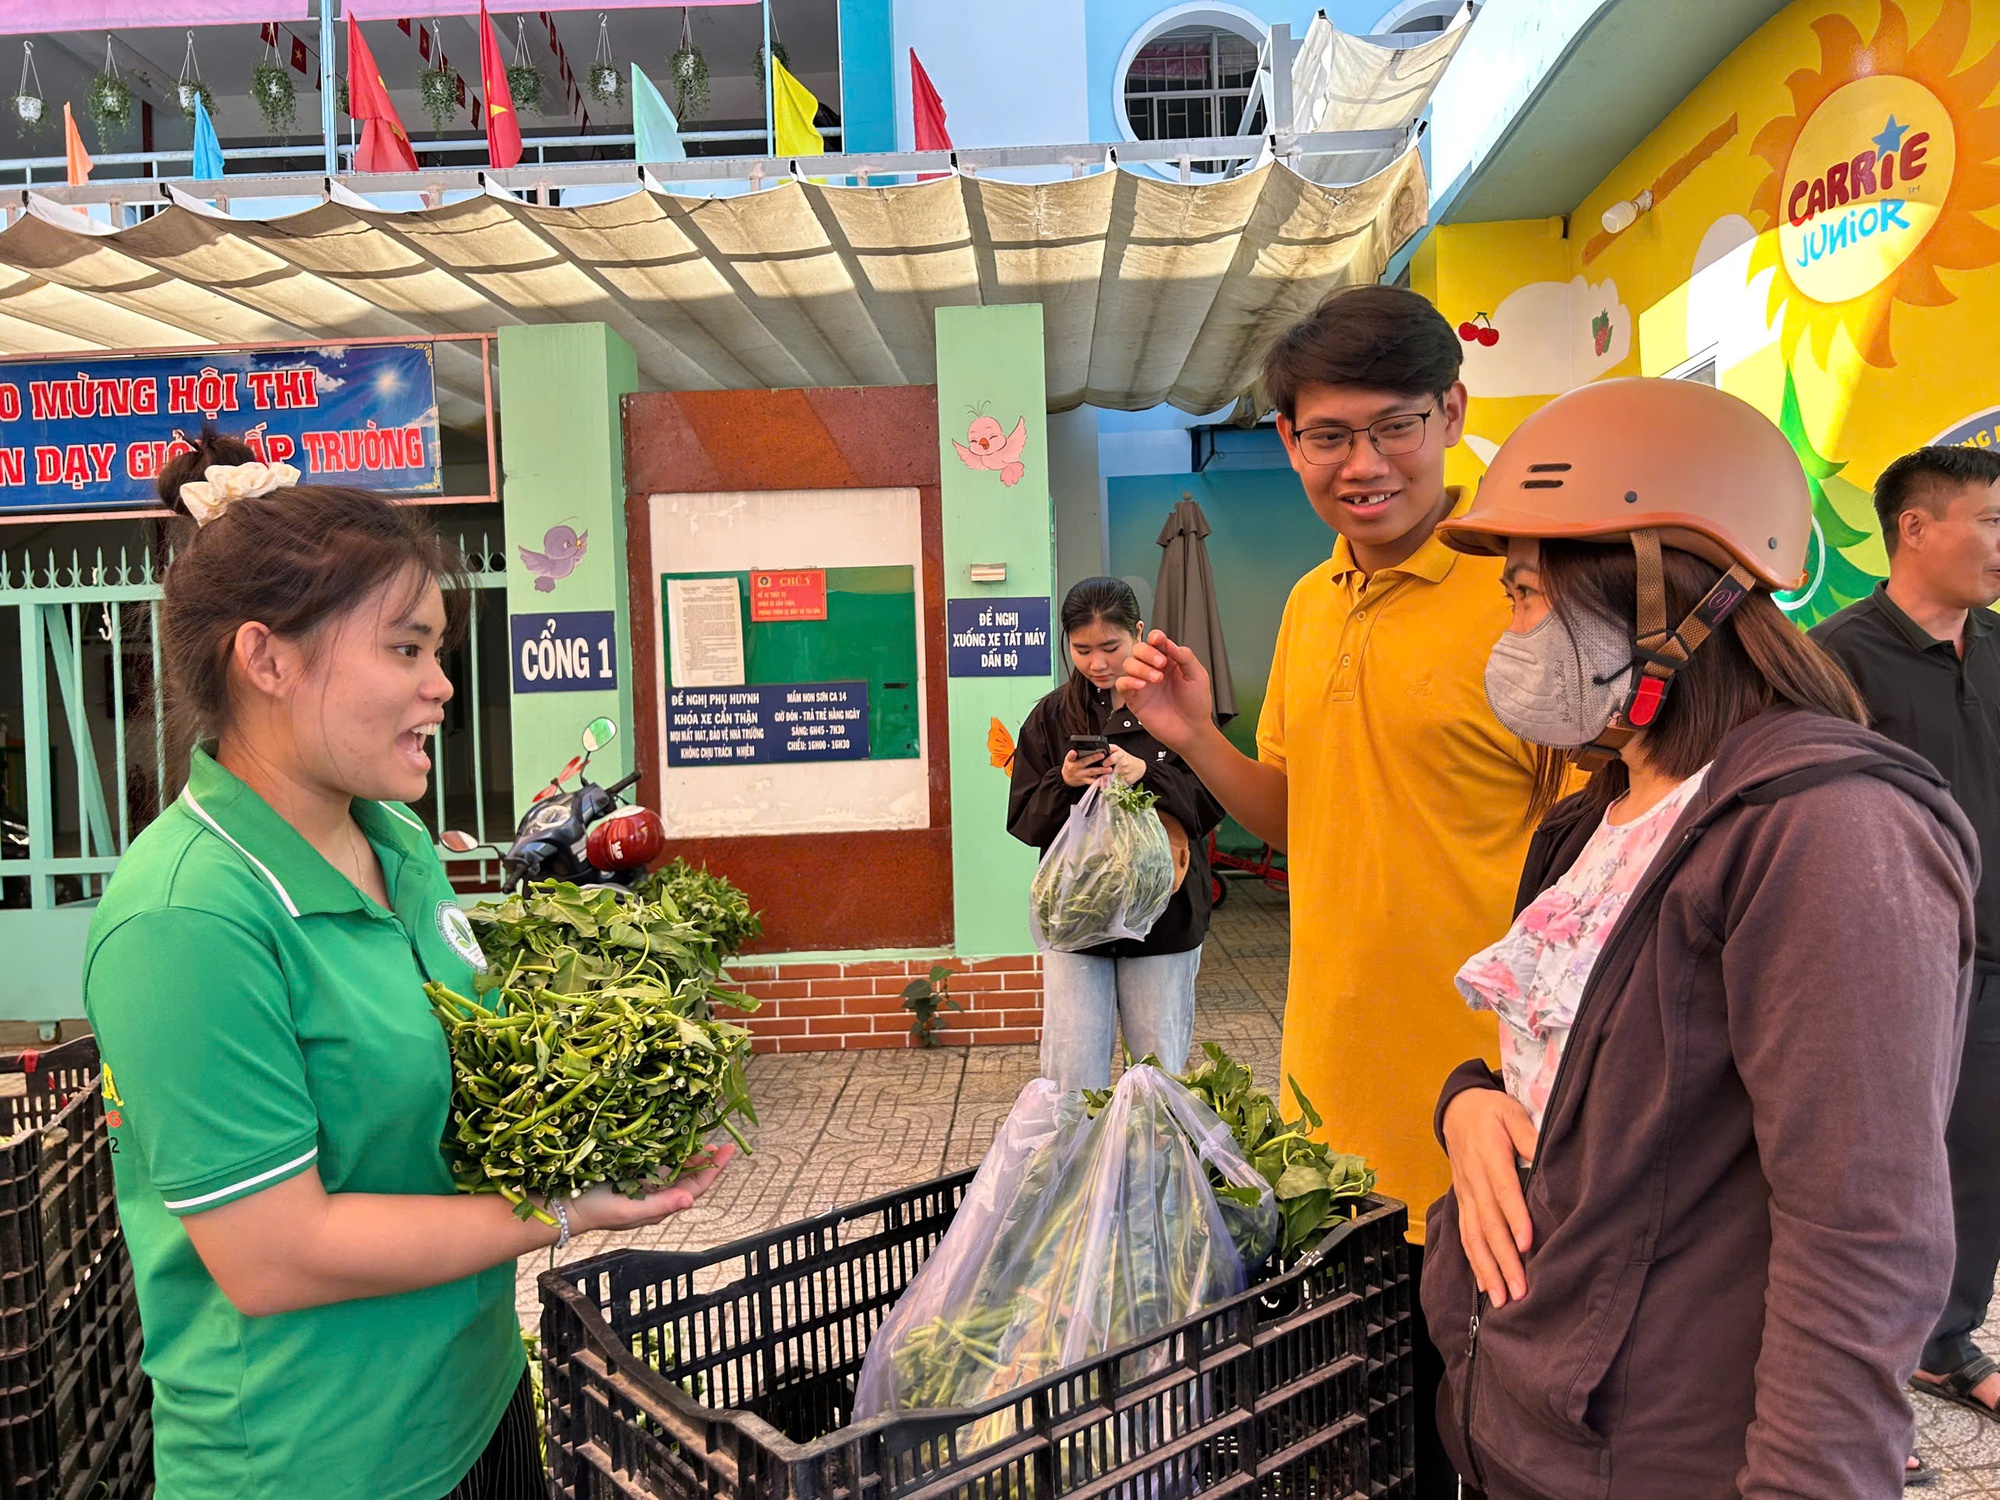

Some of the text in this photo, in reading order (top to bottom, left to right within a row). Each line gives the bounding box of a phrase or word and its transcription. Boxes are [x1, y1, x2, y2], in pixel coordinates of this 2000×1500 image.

[29, 371, 158, 420] MỪNG
[168, 366, 239, 419] HỘI
[246, 368, 319, 410] THI
[34, 443, 116, 489] DẠY
[302, 419, 424, 473] TRƯỜNG
[979, 606, 1018, 629] ĐỀ NGHỊ
[953, 627, 1046, 647] XUỐNG XE TẮT MÁY
[522, 618, 612, 681] CỔNG 1
[1004, 650, 1018, 670] BỘ
[686, 694, 707, 708] NGHỊ
[709, 693, 727, 706] PHỤ
[730, 693, 759, 704] HUYNH
[829, 692, 838, 702] CA
[839, 692, 847, 701] 14
[674, 710, 698, 725] KHÓA
[701, 713, 712, 724] XE
[734, 710, 758, 726] THẬN
